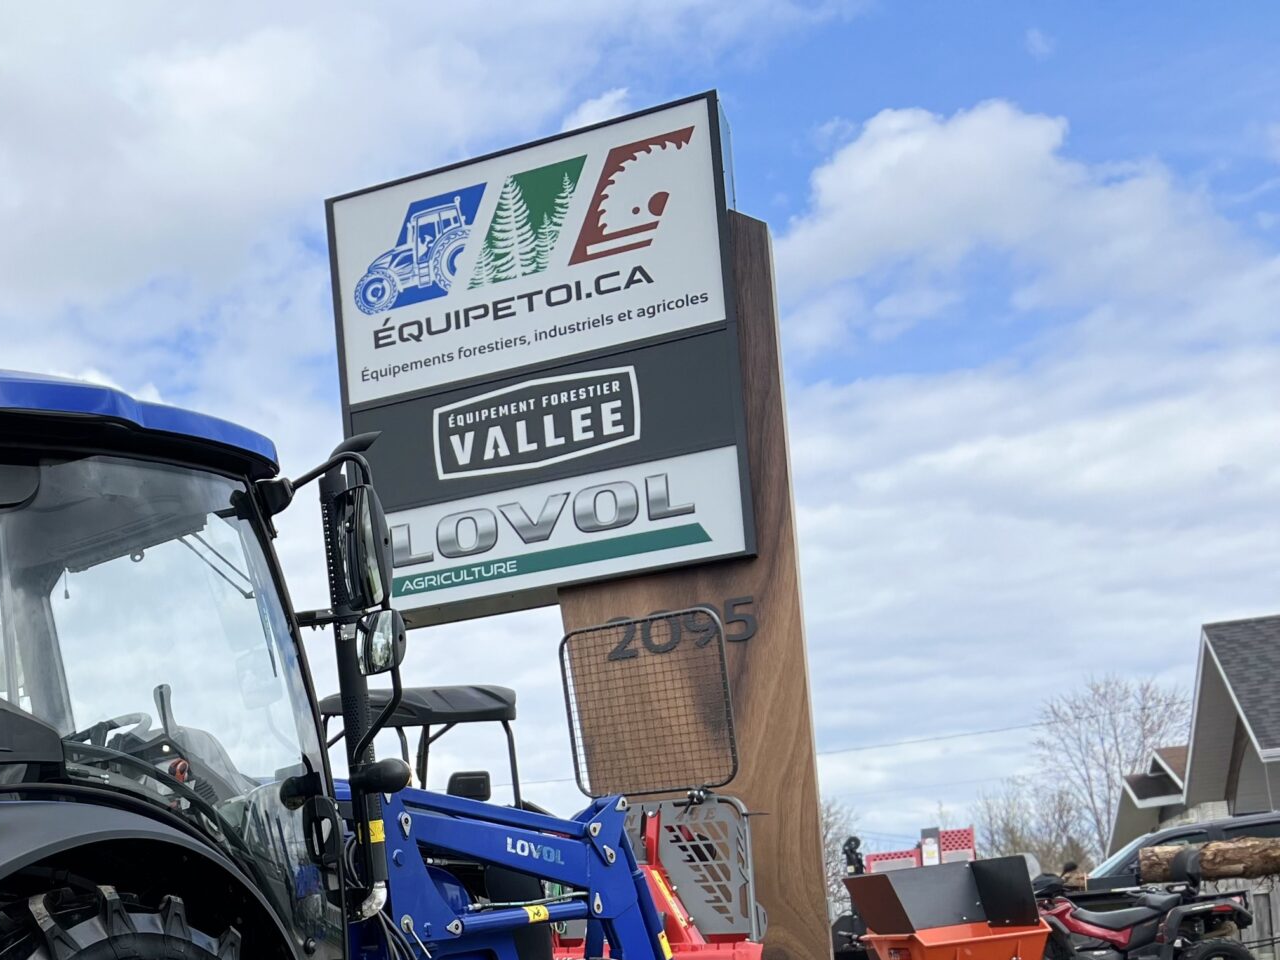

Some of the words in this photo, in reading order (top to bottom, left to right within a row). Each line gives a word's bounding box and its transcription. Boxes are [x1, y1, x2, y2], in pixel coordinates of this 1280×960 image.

[361, 352, 455, 382] Équipements
[457, 331, 531, 361] forestiers,
[534, 314, 614, 341] industriels
[617, 308, 633, 322] et
[636, 290, 709, 321] agricoles
[373, 265, 655, 349] ÉQUIPETOI.CA
[448, 398, 536, 428] ÉQUIPEMENT
[542, 380, 621, 408] FORESTIER
[449, 400, 625, 466] VALLEE
[390, 472, 696, 569] LOVOL
[401, 560, 518, 592] AGRICULTURE
[605, 596, 759, 662] 2095
[506, 836, 565, 865] LOVOL
